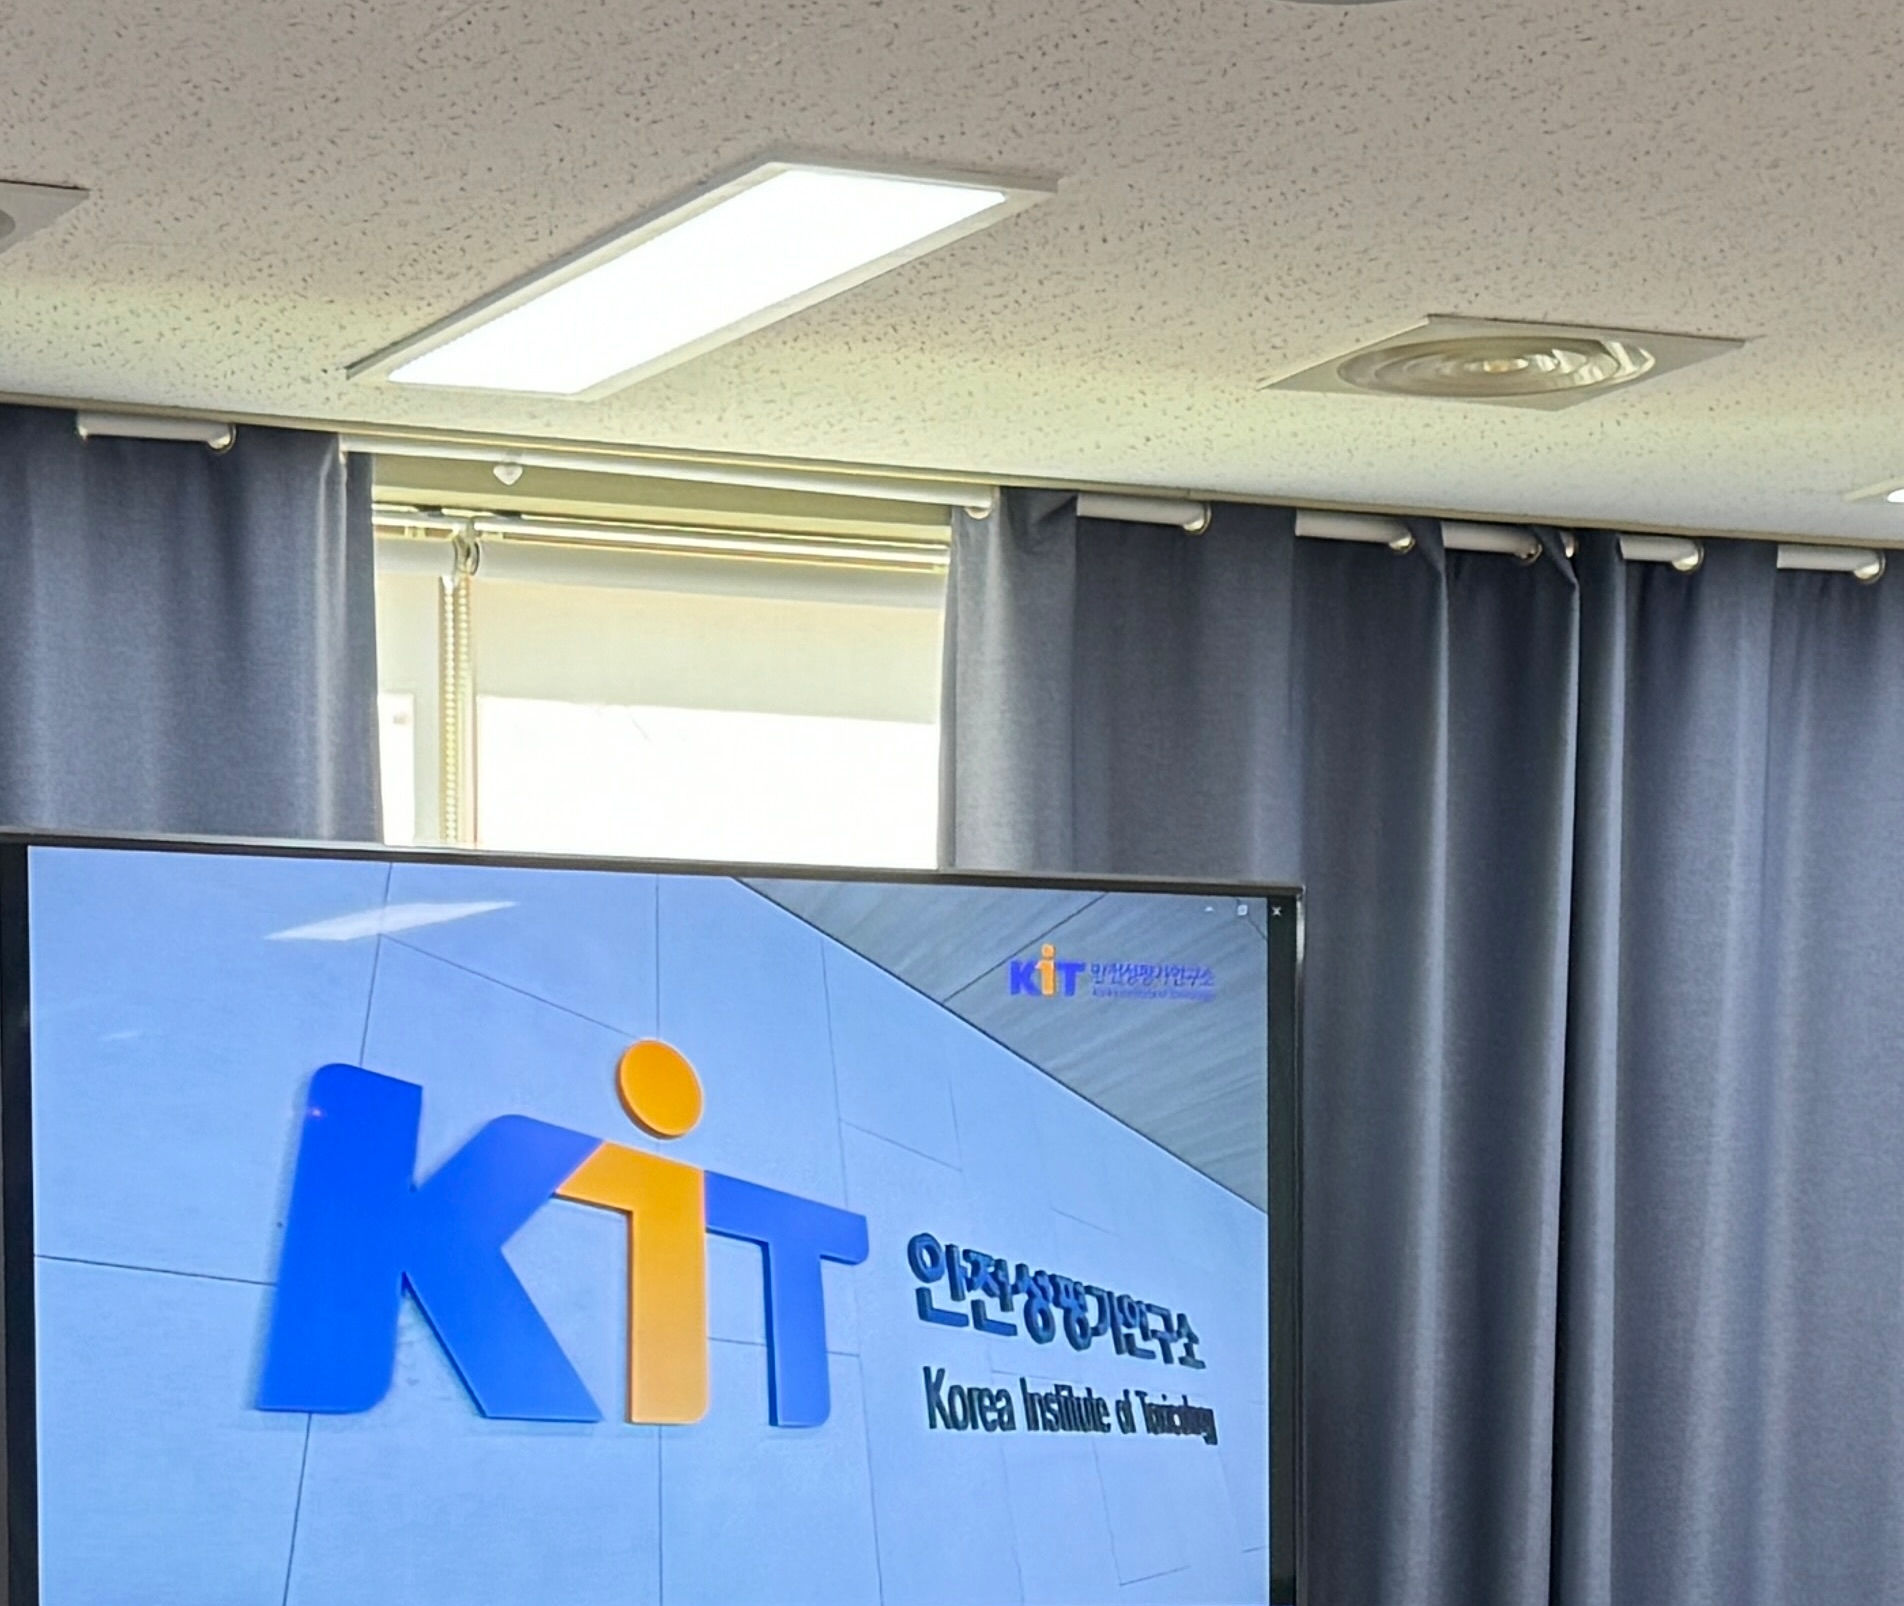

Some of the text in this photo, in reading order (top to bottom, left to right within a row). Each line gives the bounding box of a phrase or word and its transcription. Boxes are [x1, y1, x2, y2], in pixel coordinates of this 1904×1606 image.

[907, 1233, 1206, 1369] 안전성평가연구소
[923, 1366, 1016, 1433] Korea
[1020, 1377, 1111, 1433] Institute
[1115, 1389, 1136, 1434] of
